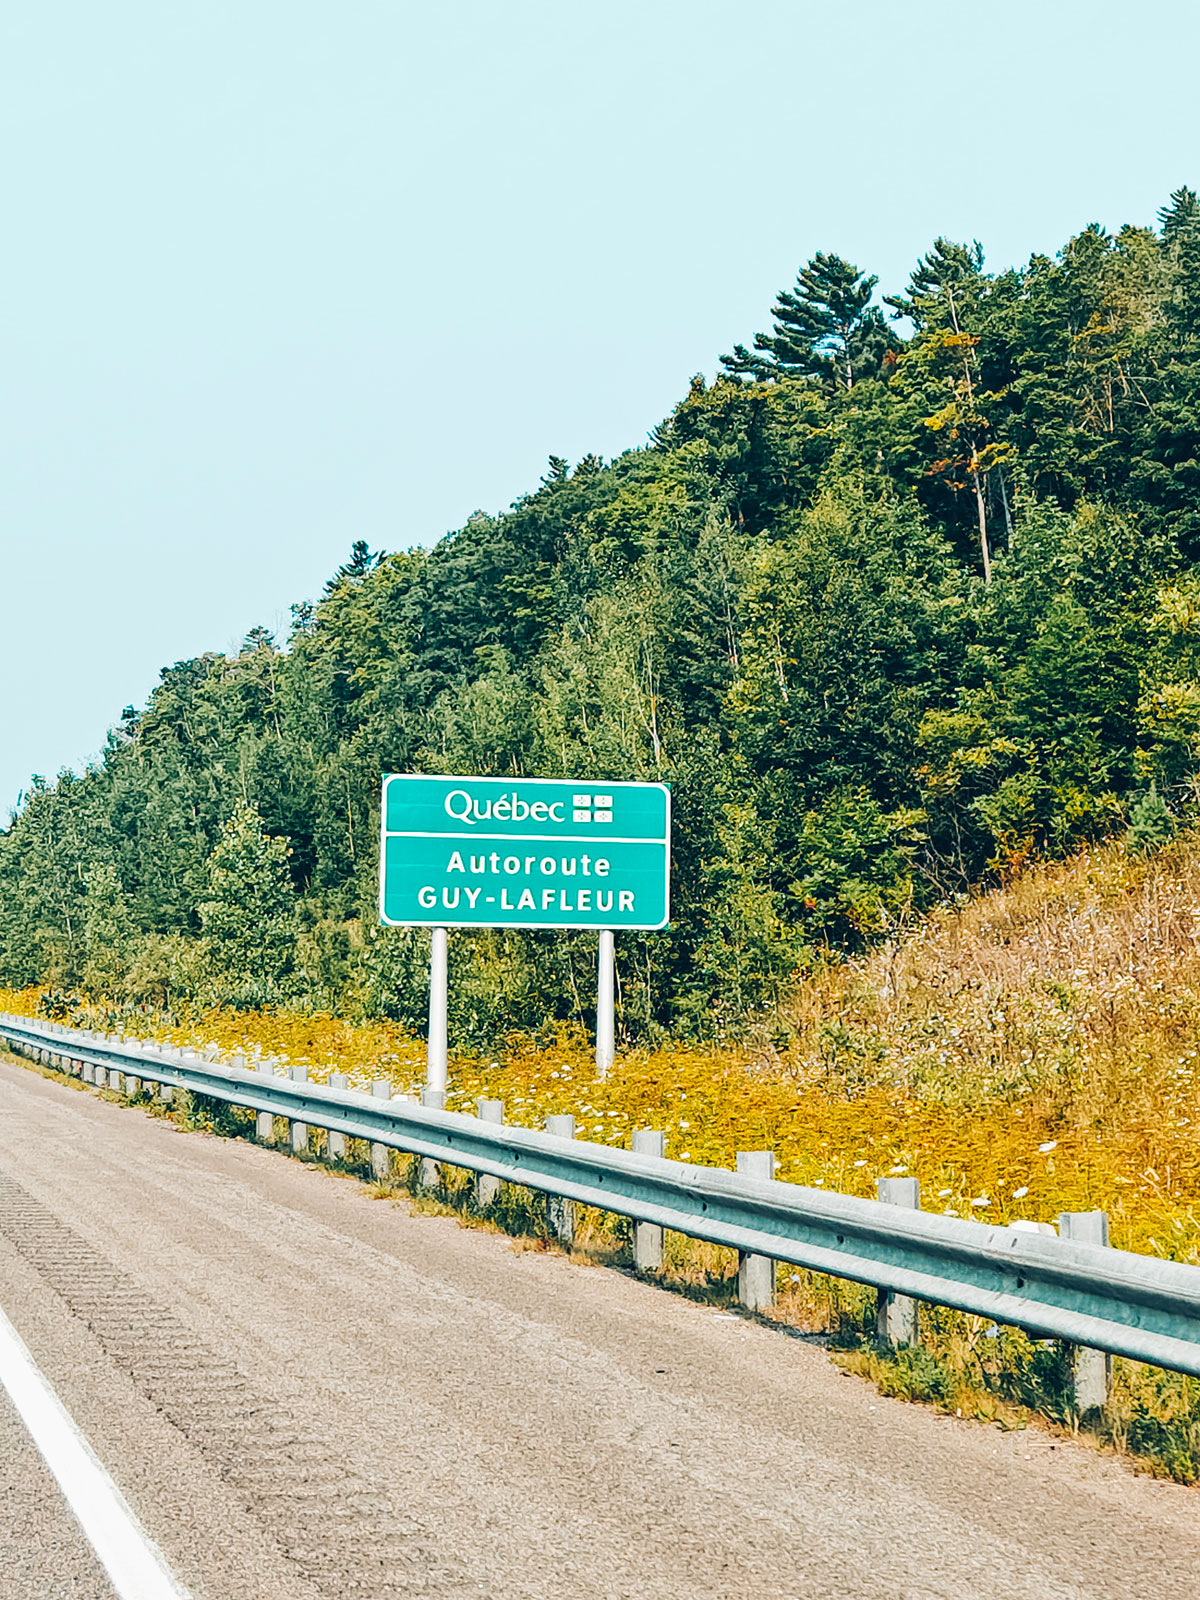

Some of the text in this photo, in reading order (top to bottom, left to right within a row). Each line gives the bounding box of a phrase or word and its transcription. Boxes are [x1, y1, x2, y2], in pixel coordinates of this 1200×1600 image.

[444, 789, 565, 825] Québec
[446, 851, 611, 877] Autoroute
[417, 886, 635, 912] GUY-LAFLEUR
